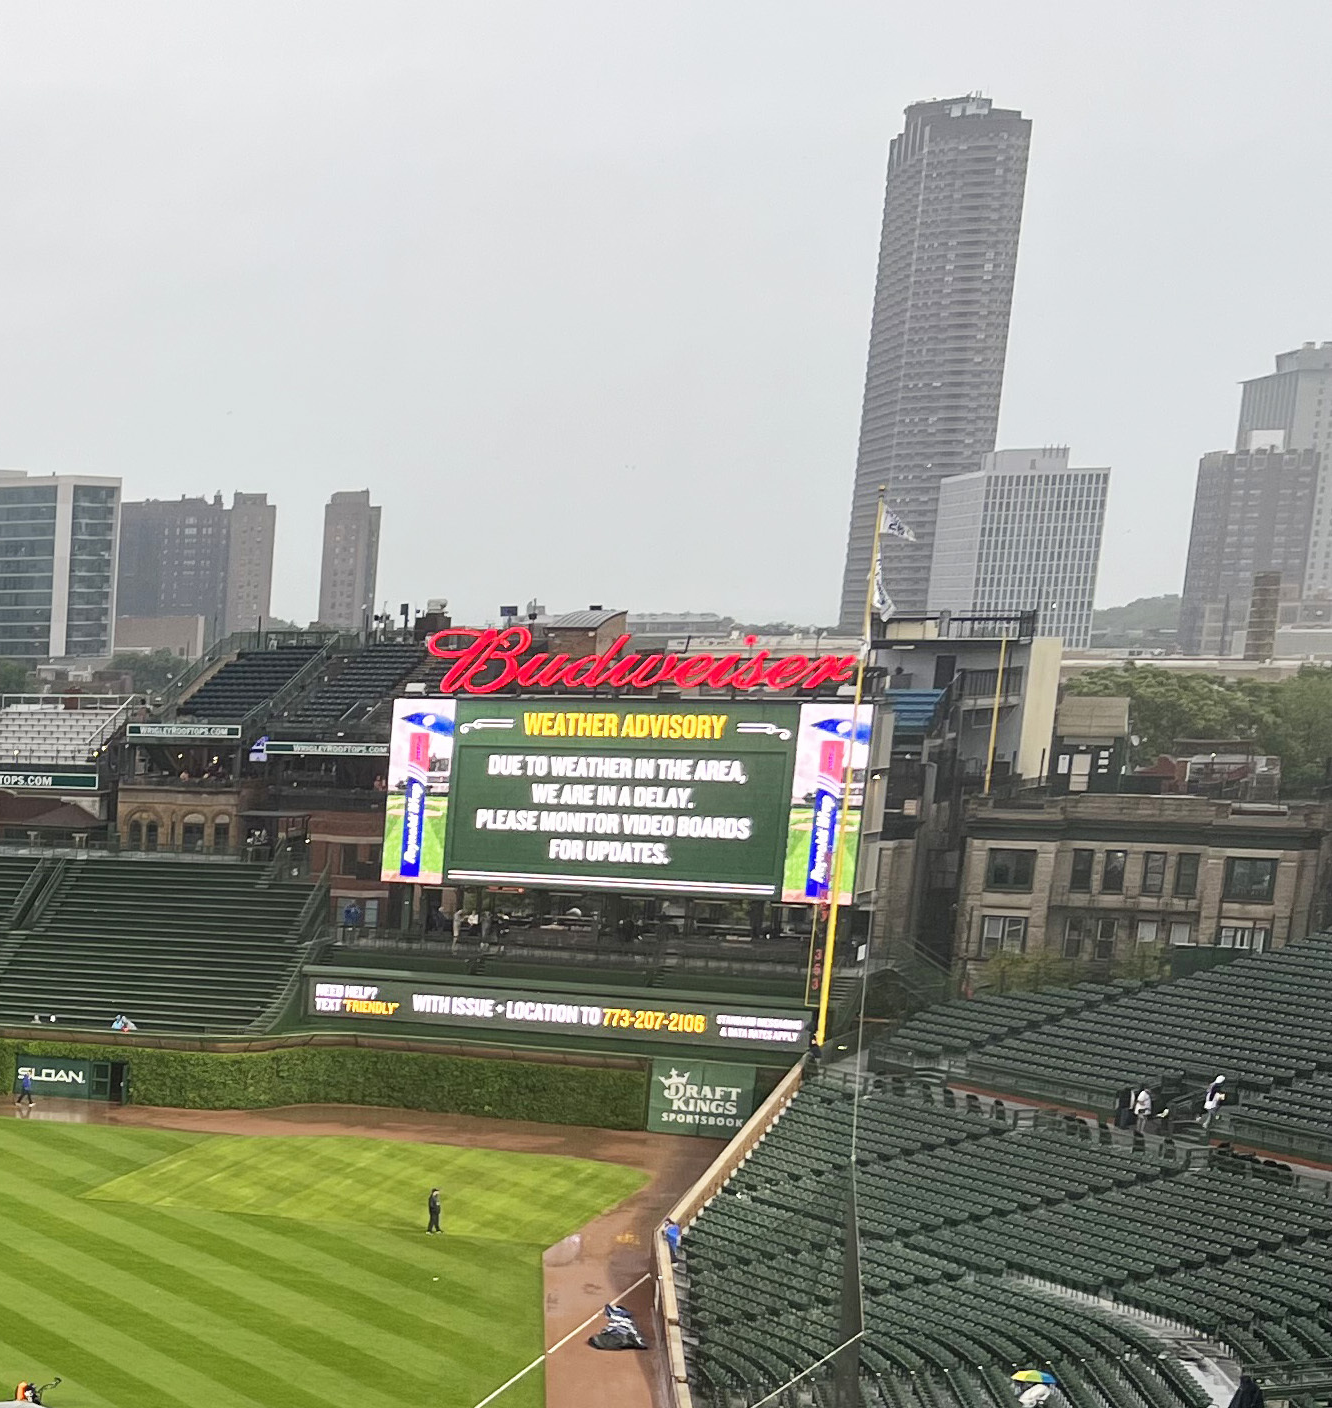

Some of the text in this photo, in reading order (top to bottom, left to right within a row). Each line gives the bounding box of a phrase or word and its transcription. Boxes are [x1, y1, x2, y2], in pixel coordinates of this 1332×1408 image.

[427, 626, 858, 693] Budweiser
[524, 713, 728, 740] WEATHER ADVISORY
[488, 755, 748, 784] DUE TO WEATHER IN THE AREA,
[532, 783, 695, 809] WE ARE IN A DELAY.
[476, 809, 751, 840] PLEASE MONITOR VIDEO BOARDS
[549, 839, 671, 865] FOR UPDATES.
[315, 984, 378, 1000] NEED HELP?
[315, 998, 399, 1015] TEXT "FRIENDLY"
[412, 994, 449, 1014] WITH
[452, 996, 495, 1018] ISSUE
[506, 1002, 578, 1024] LOCATION
[580, 1006, 600, 1026] TO
[17, 1067, 85, 1084] SLOAN
[663, 1082, 742, 1101] DRAFT
[671, 1097, 738, 1115] KINGS
[661, 1112, 744, 1127] SPORTSBOOK
